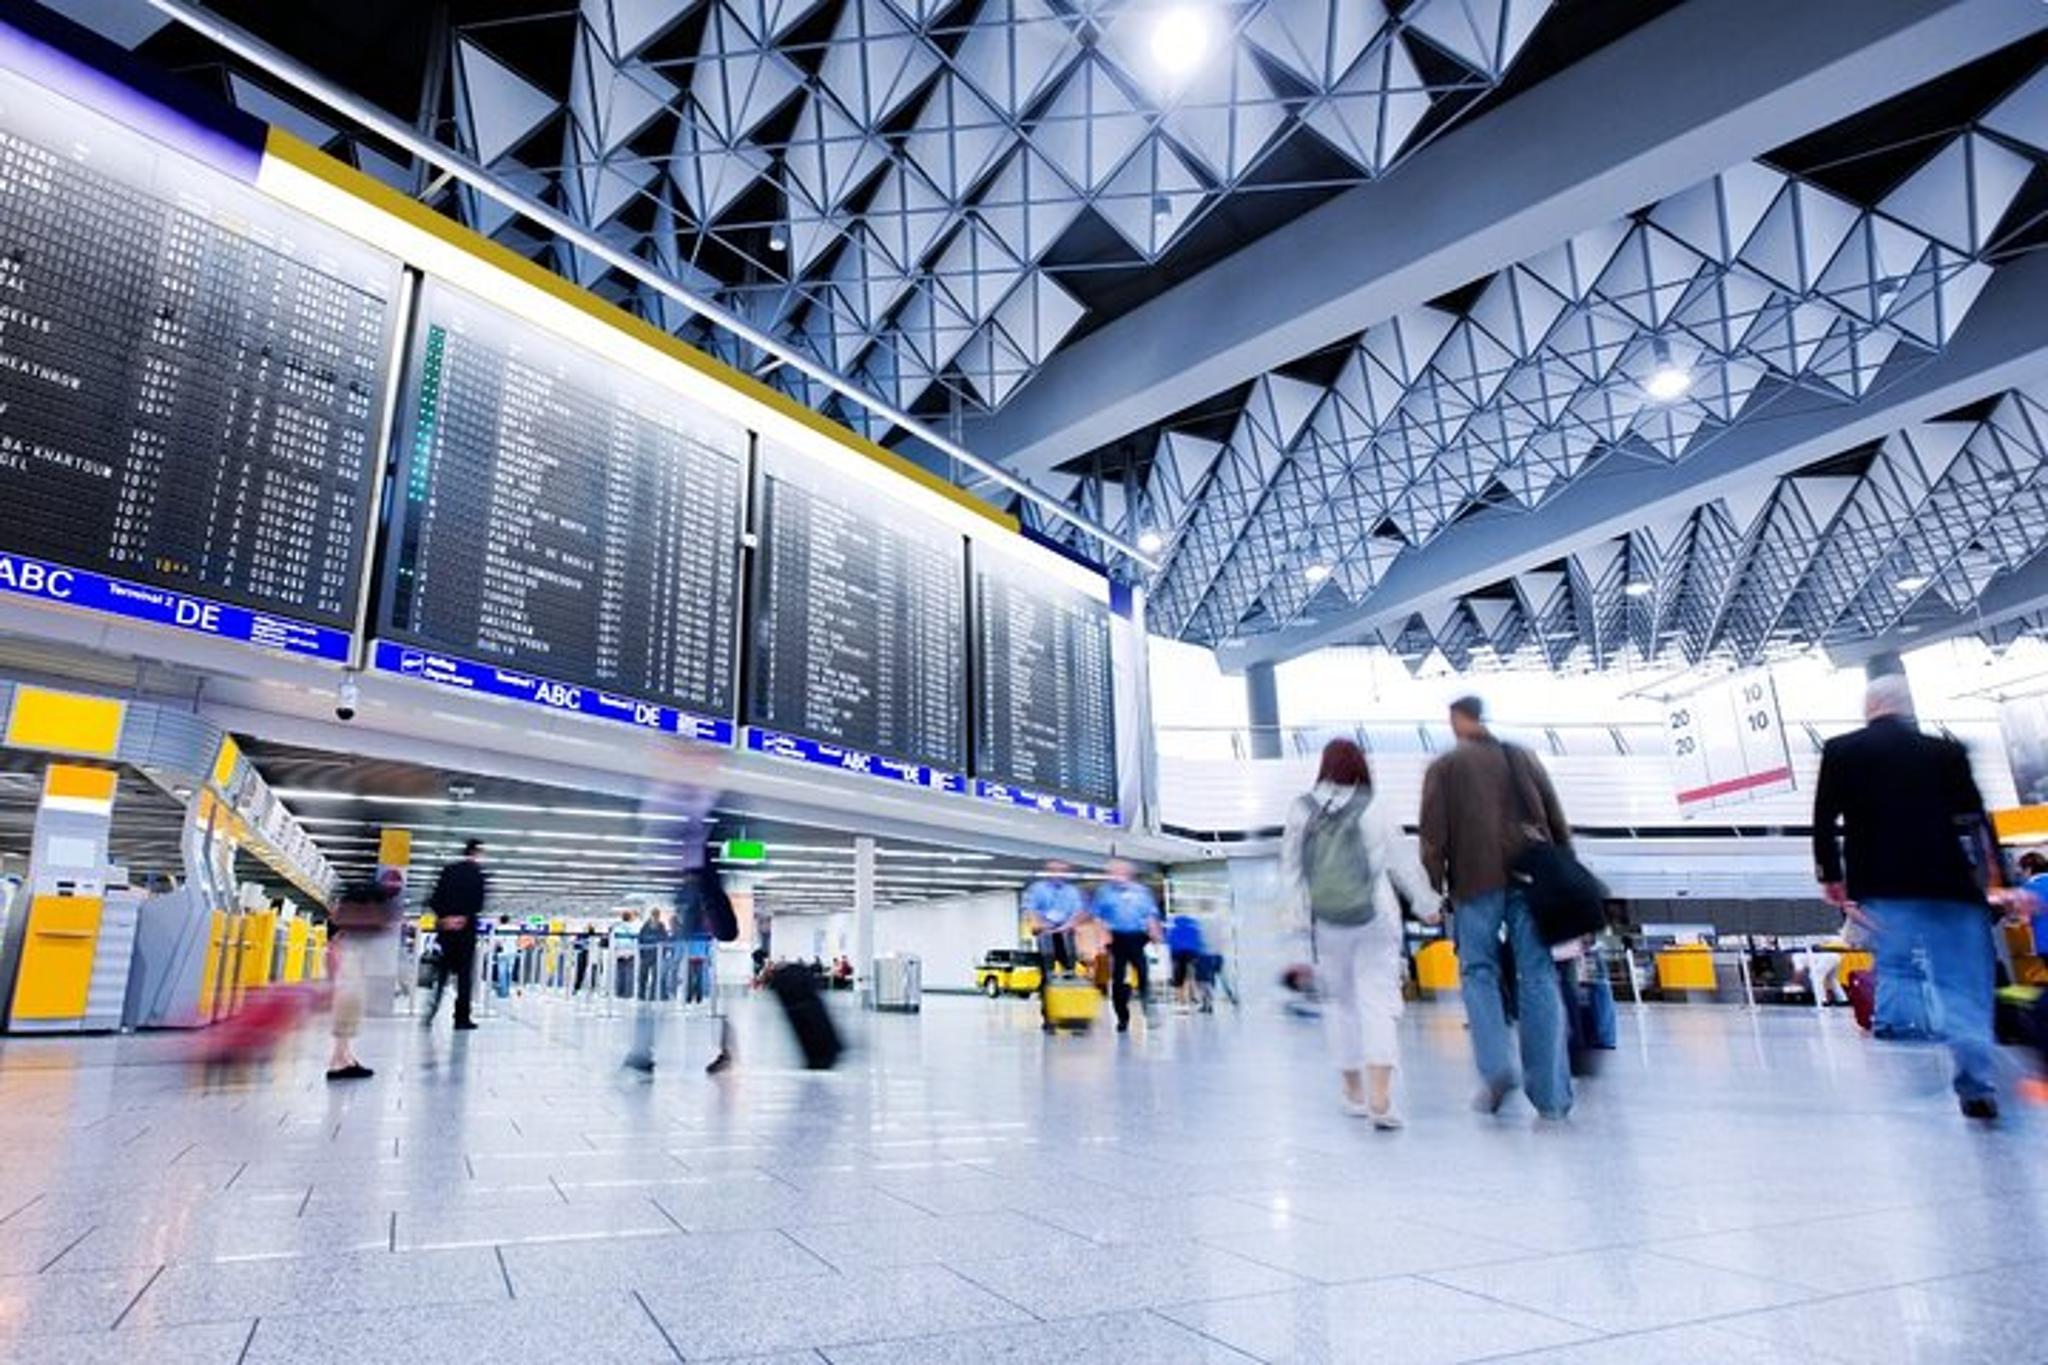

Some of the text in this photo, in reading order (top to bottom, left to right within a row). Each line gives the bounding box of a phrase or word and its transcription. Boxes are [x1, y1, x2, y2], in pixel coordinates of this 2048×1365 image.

[0, 557, 75, 599] ABC
[109, 583, 165, 607] Terminal
[175, 600, 220, 631] DE
[535, 684, 581, 711] ABC
[1742, 683, 1762, 704] 10
[635, 704, 661, 727] DE
[1670, 708, 1690, 729] 20
[1748, 710, 1769, 732] 10
[1675, 735, 1696, 756] 20
[841, 752, 870, 773] ABC
